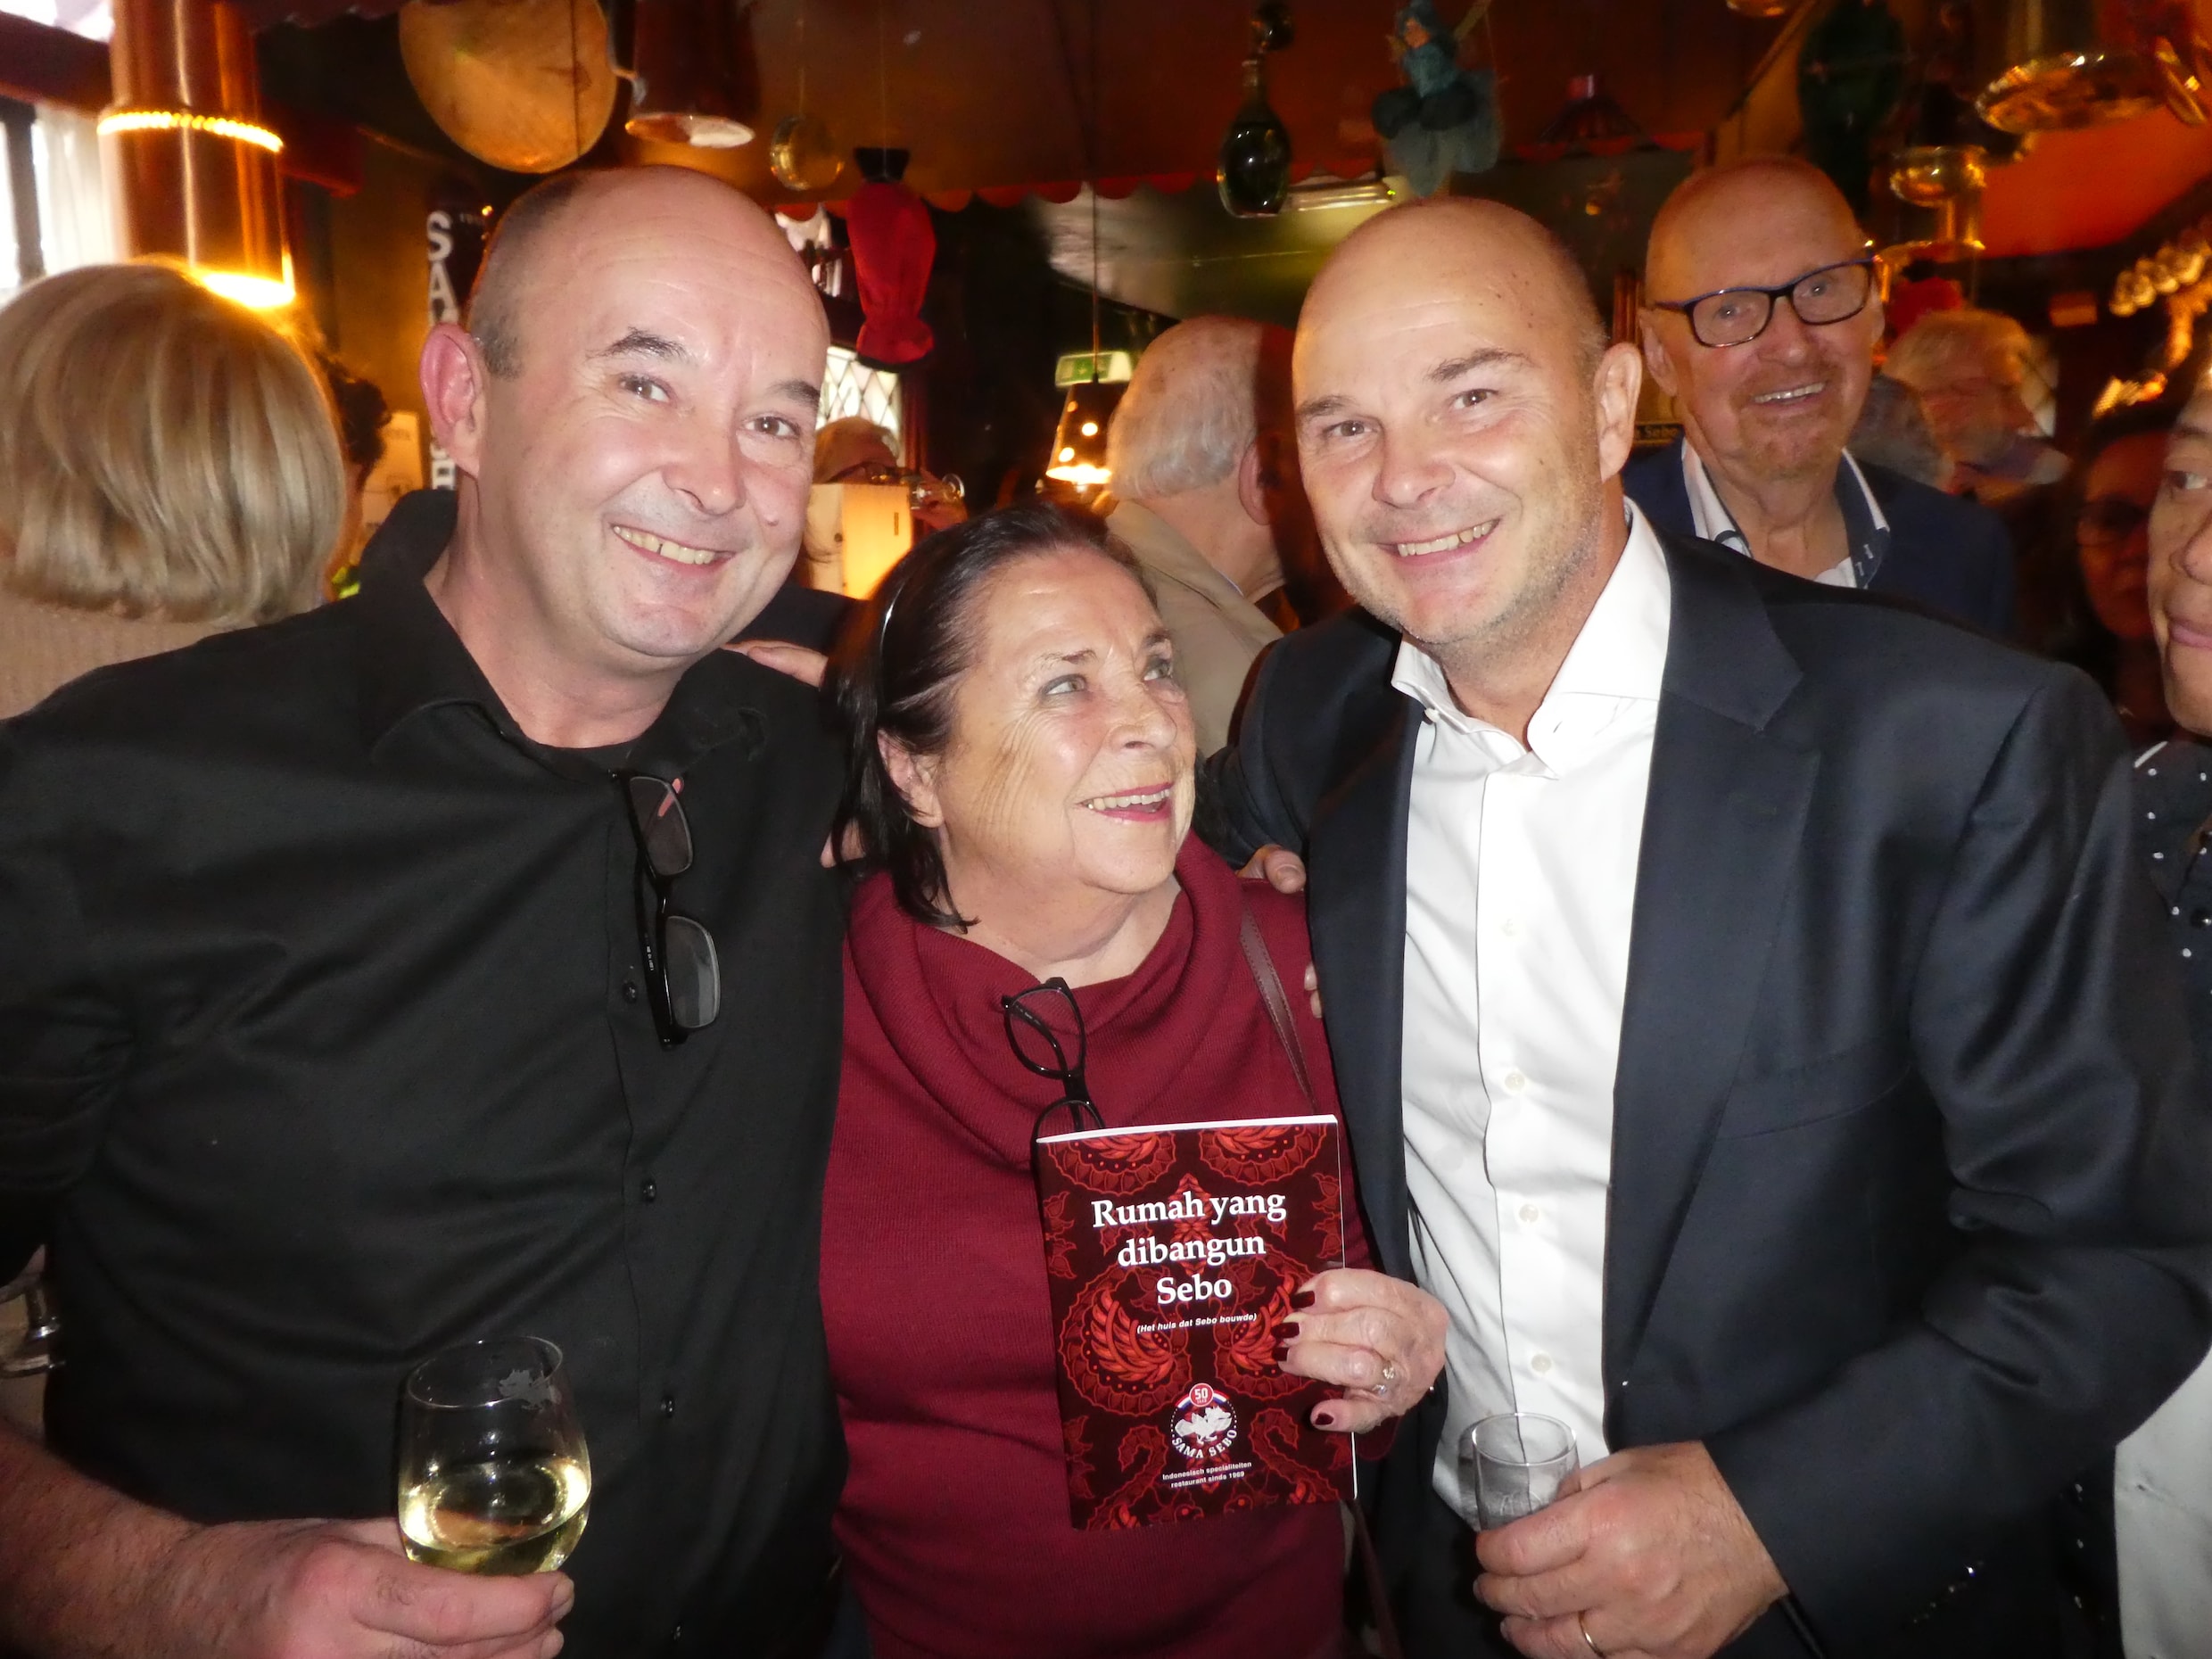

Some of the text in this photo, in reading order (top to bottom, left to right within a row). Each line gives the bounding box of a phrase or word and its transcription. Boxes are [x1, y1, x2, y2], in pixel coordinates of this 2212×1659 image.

[1091, 1191, 1287, 1228] Rumah yang
[1117, 1234, 1267, 1267] dibangun
[1156, 1274, 1232, 1305] Sebo
[1136, 1312, 1258, 1334] (Het huis dat Sebo bouwde)
[1194, 1387, 1209, 1399] 50
[1171, 1429, 1238, 1459] SAMA SEBO
[1162, 1461, 1252, 1481] Indonesisch specialiteiten
[1170, 1477, 1207, 1489] restaurant
